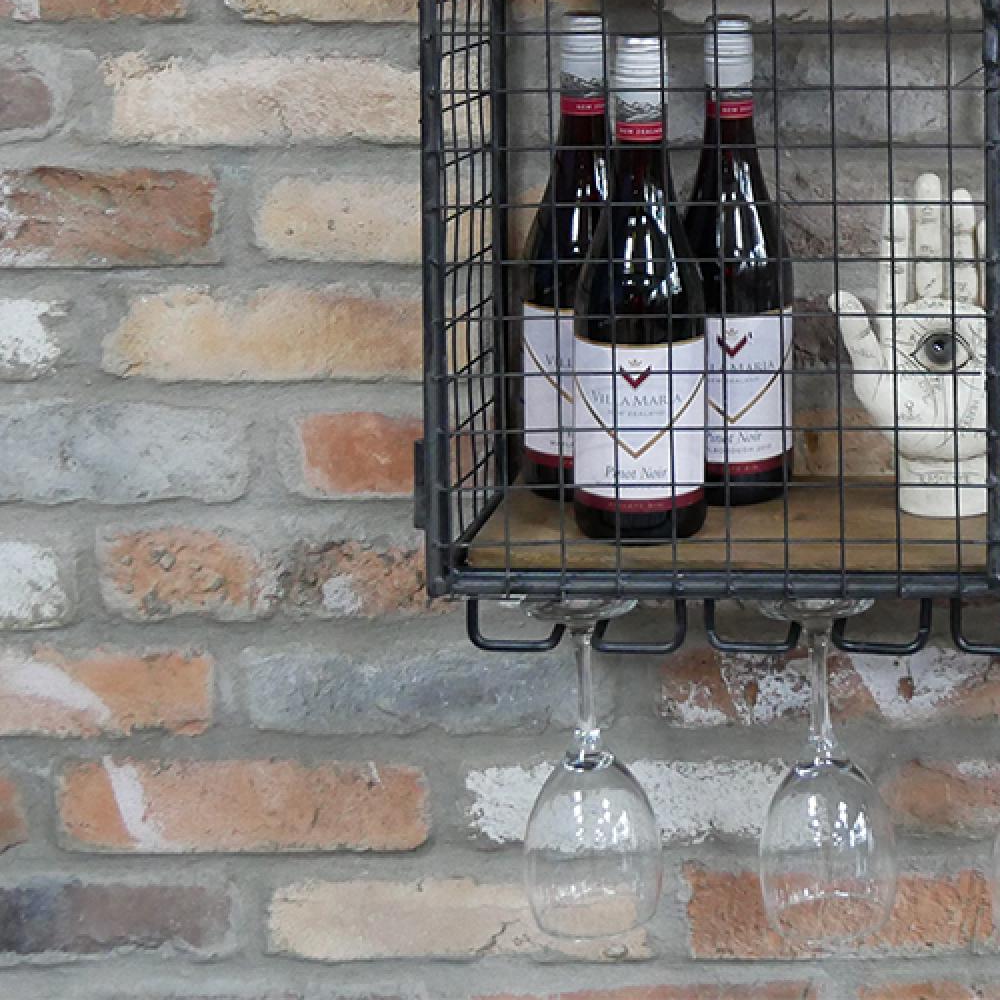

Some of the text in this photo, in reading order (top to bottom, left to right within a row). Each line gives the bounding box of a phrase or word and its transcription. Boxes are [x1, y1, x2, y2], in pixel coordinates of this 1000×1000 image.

[591, 389, 683, 407] VILA MARA
[605, 465, 637, 480] Pnot
